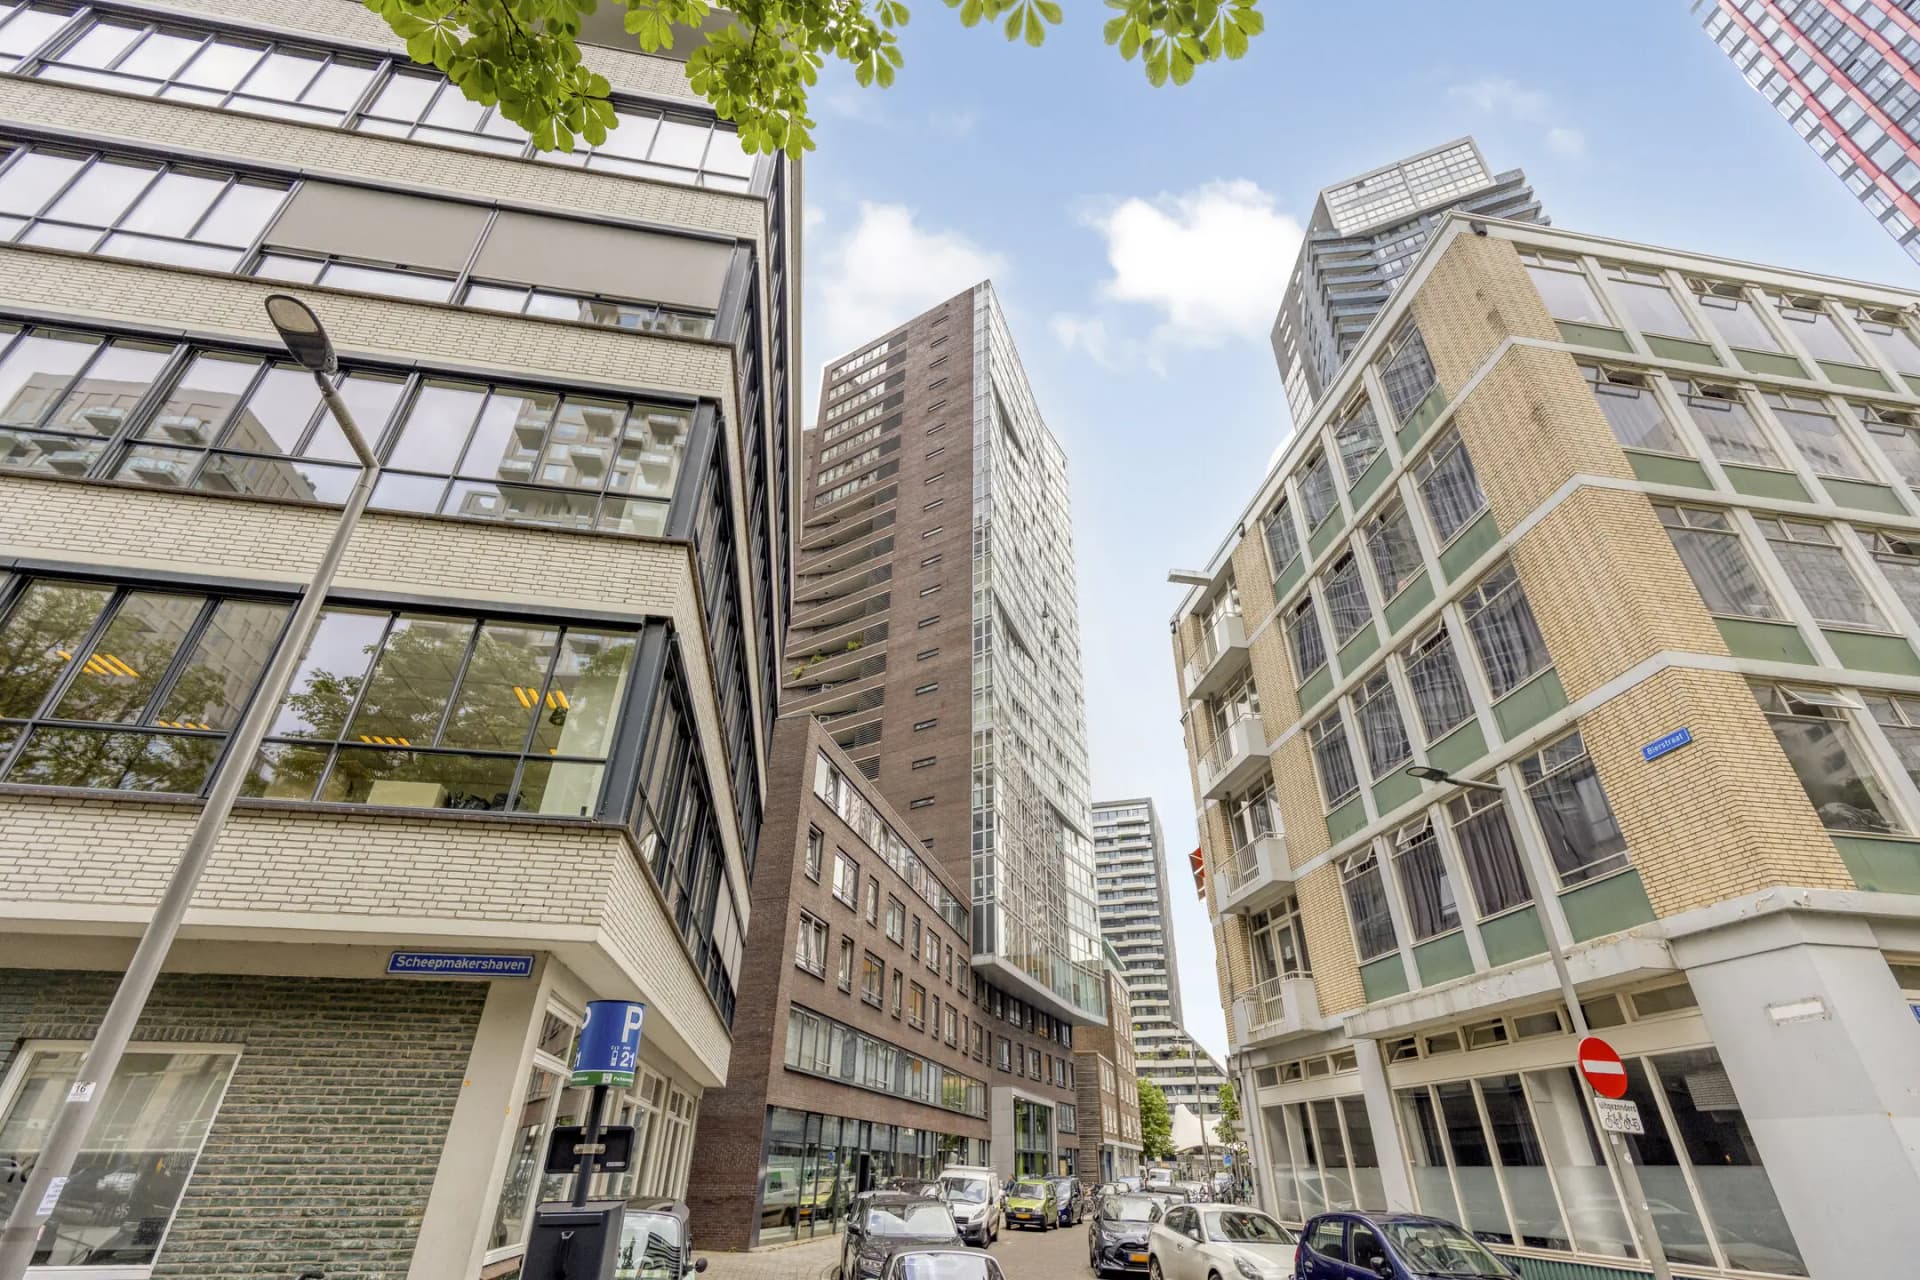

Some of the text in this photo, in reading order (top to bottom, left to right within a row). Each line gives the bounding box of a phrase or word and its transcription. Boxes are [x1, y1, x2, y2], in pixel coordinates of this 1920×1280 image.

[1646, 732, 1684, 756] Bierstraat
[396, 955, 526, 971] Scheepmakershaven
[621, 1005, 643, 1043] P
[619, 1051, 635, 1068] 21
